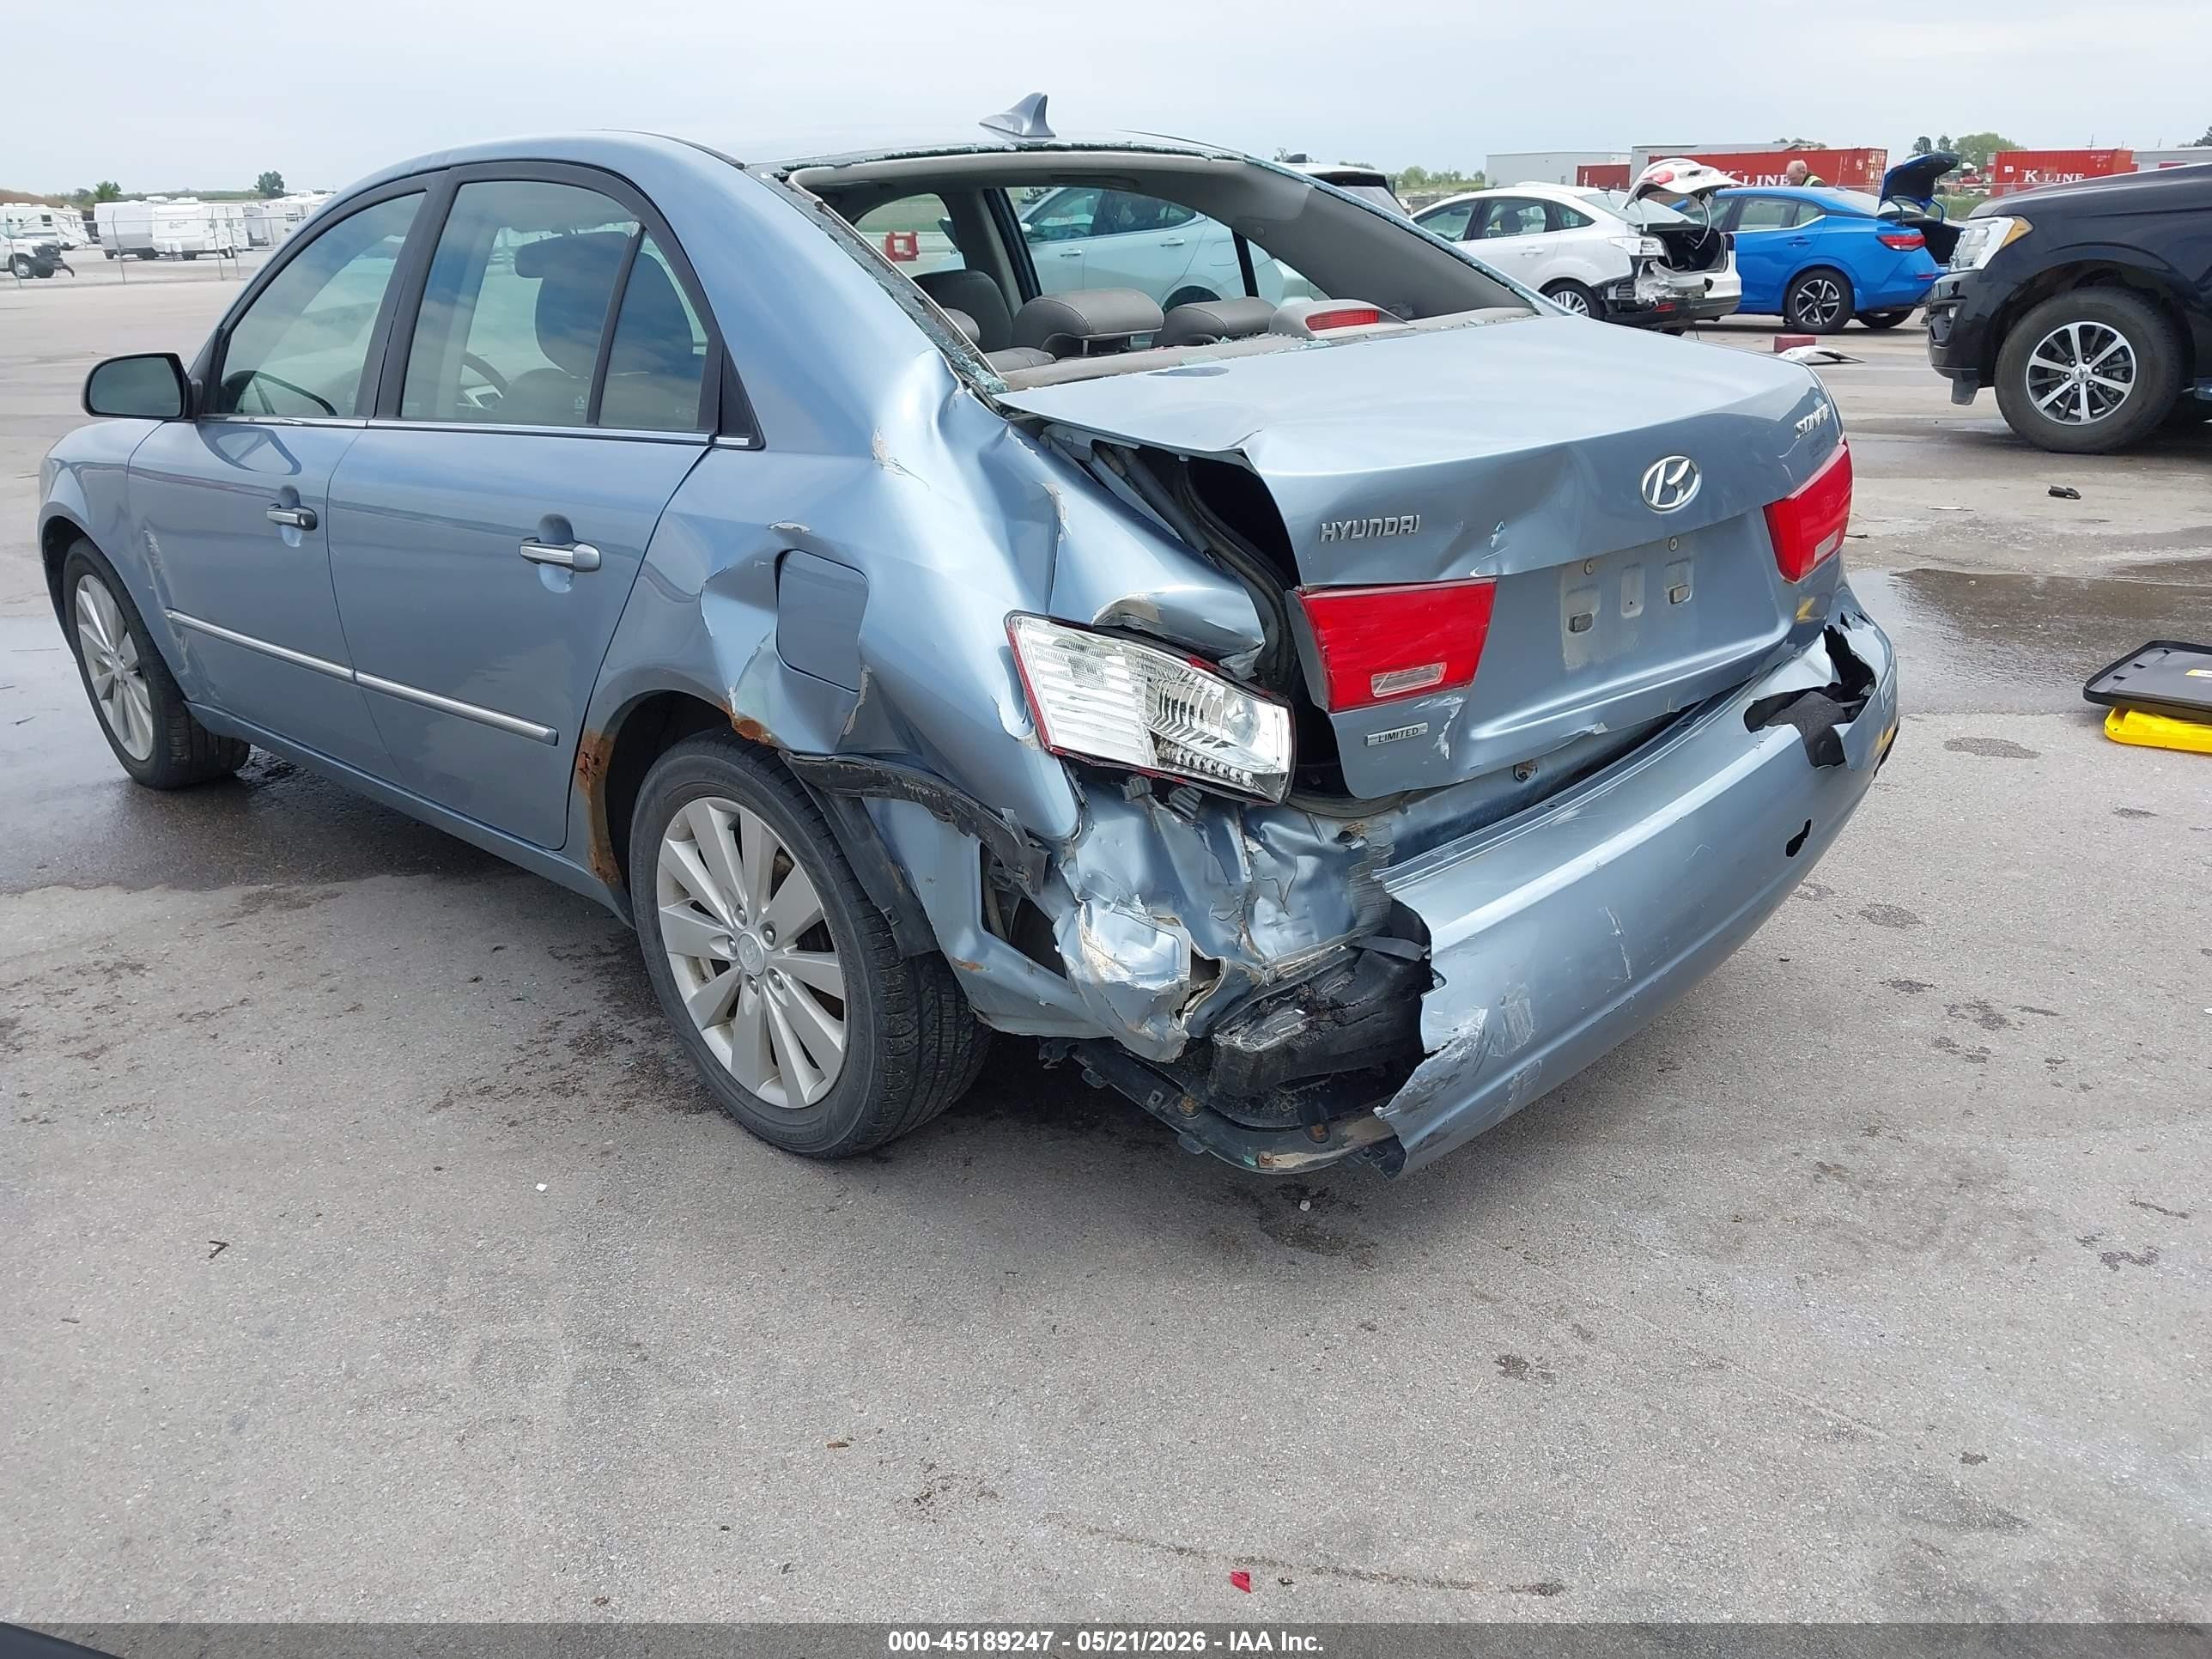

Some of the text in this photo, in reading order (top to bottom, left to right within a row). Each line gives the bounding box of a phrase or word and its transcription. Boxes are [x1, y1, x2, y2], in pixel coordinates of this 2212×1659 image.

[1743, 173, 1791, 186] LINE
[2045, 173, 2085, 184] LINE
[1320, 514, 1420, 542] HYUNDAI
[1377, 727, 1419, 743] LIMITED
